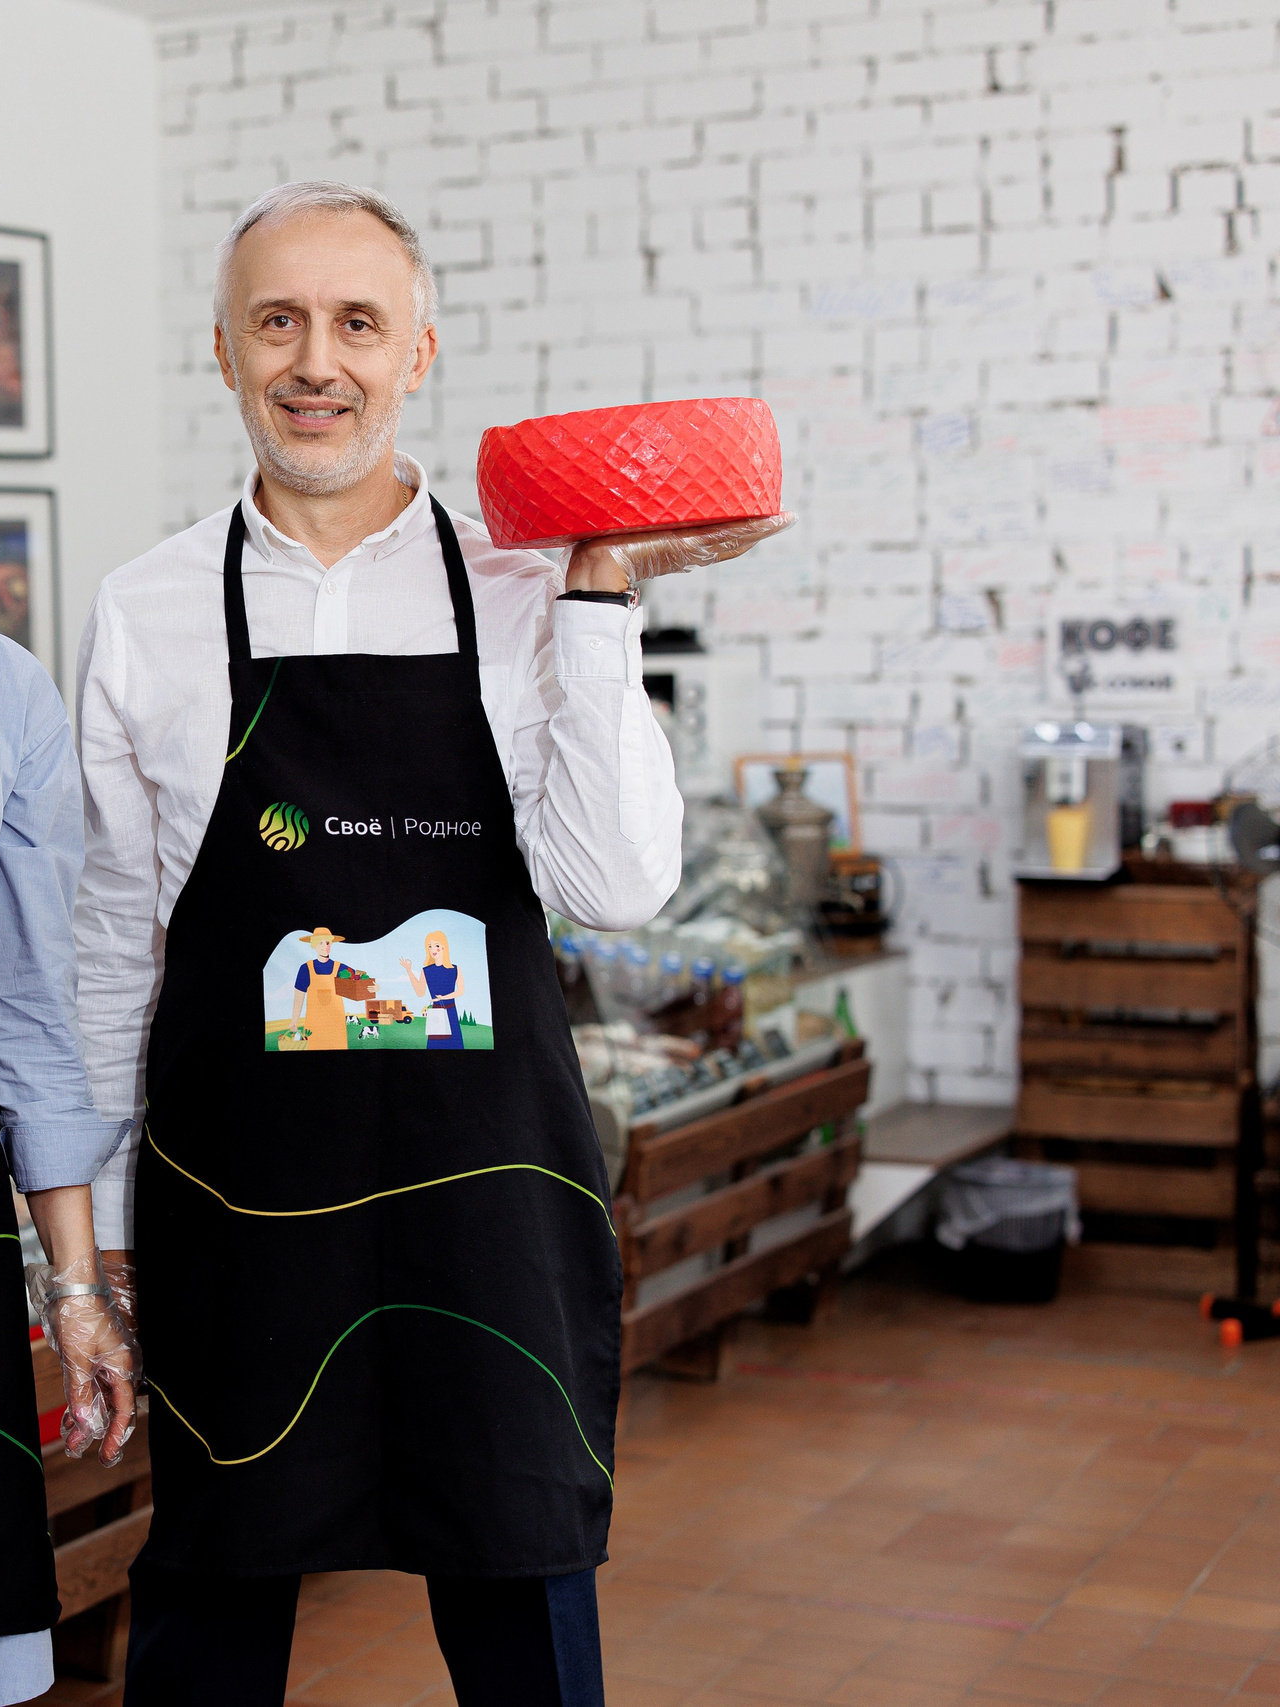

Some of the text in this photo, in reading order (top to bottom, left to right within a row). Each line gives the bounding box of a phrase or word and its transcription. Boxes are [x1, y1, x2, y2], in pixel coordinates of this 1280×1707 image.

[1061, 619, 1176, 652] КОФЕ
[325, 817, 481, 838] Своё Родное
